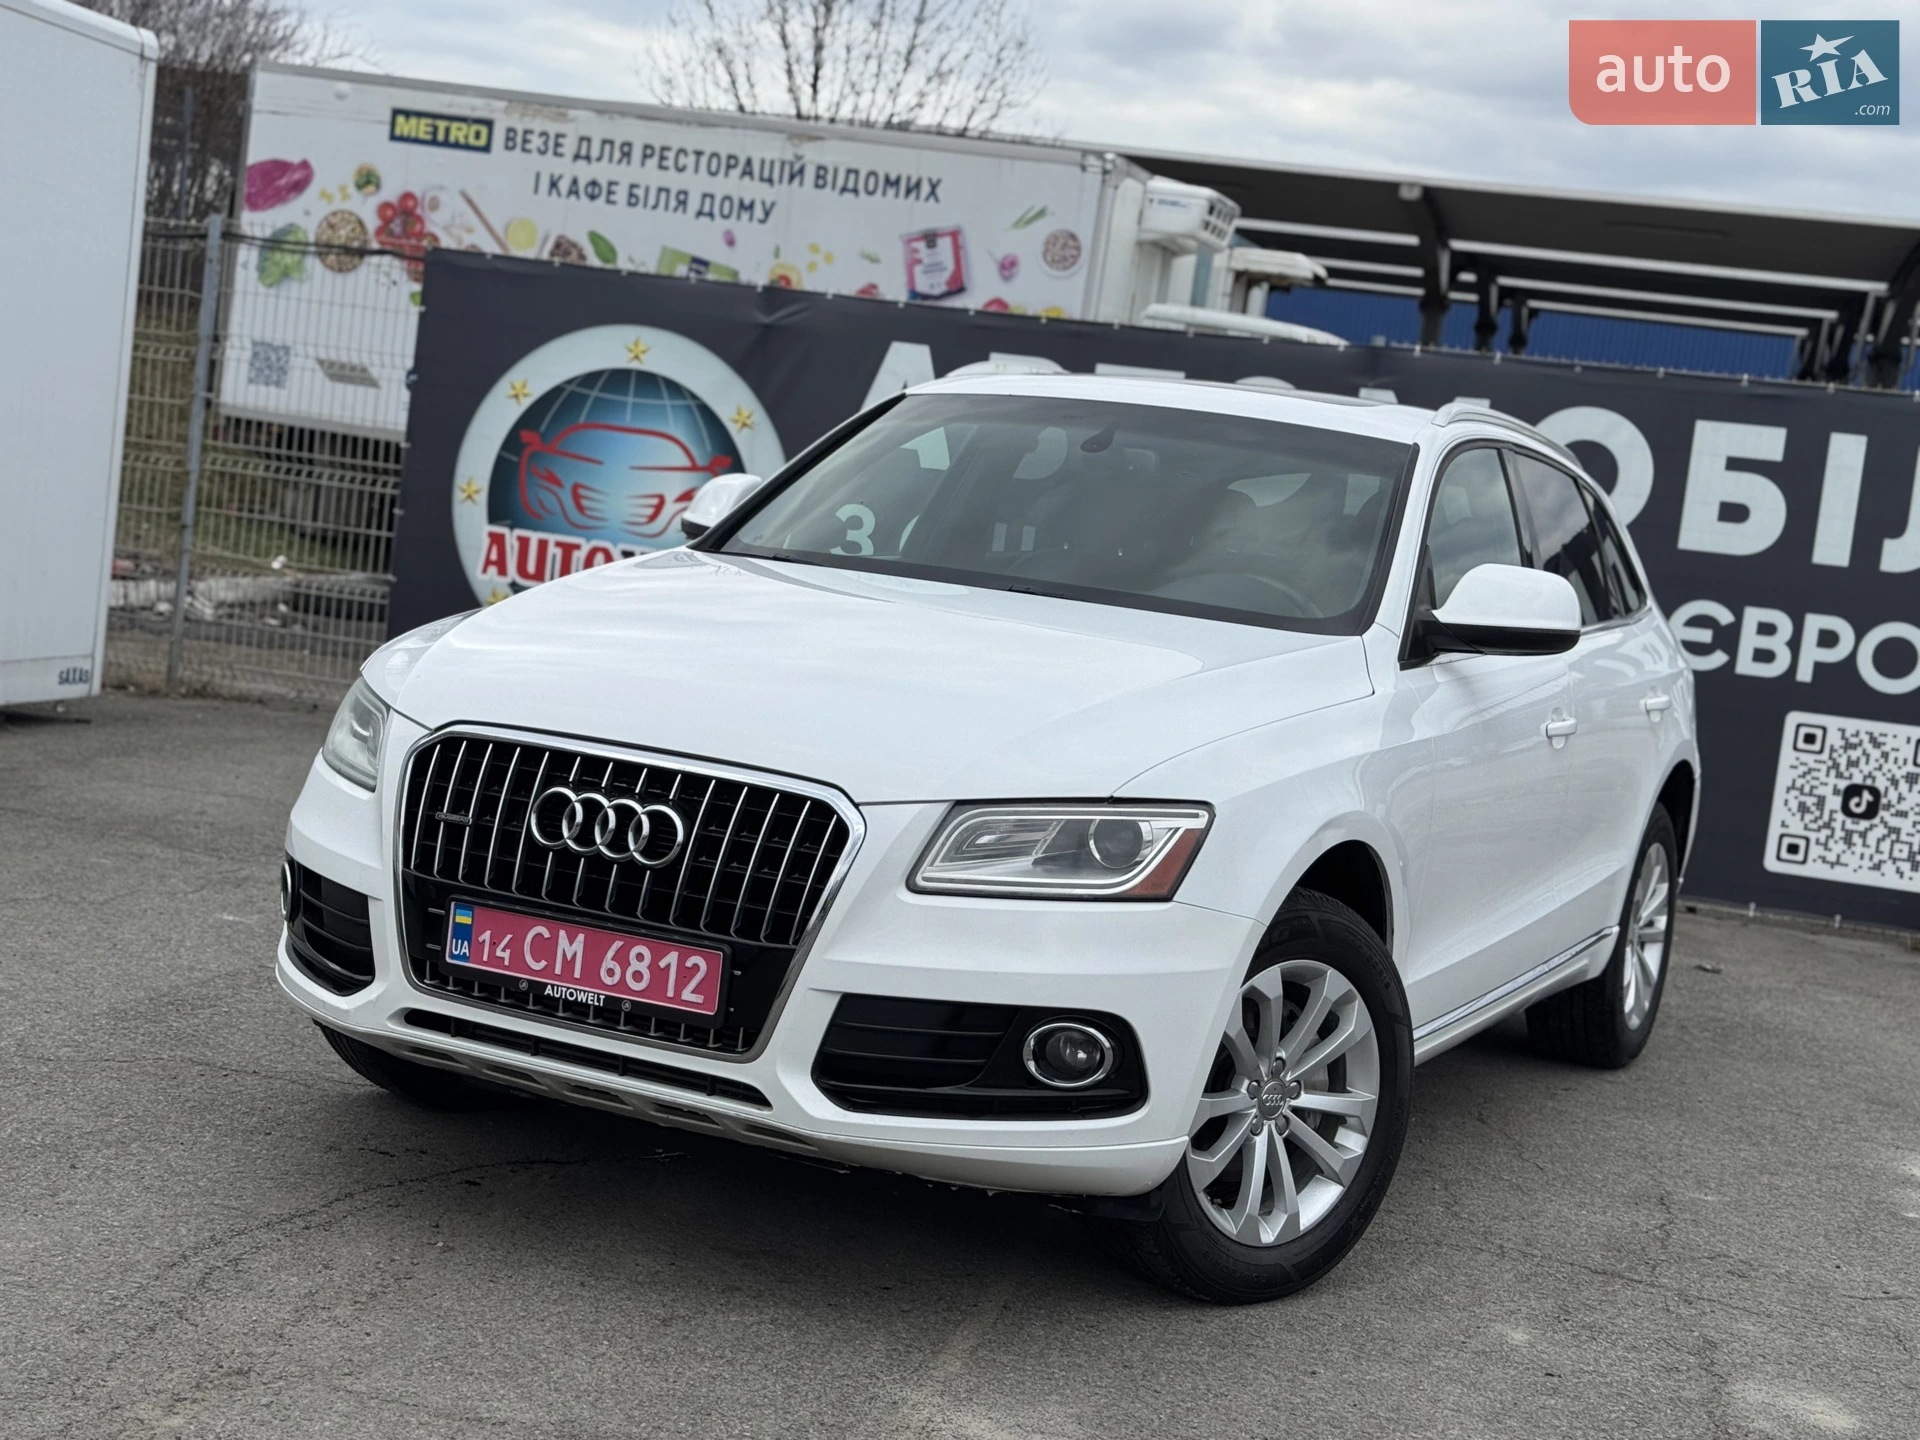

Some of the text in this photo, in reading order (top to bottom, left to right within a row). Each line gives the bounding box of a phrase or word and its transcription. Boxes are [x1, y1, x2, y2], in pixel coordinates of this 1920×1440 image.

[394, 114, 490, 148] METRO
[504, 127, 942, 203] ВЕЗЕ ДЛЯ РЕСТОРАЦІЙ ВІДОМИХ
[548, 173, 619, 206] КАФЕ
[626, 183, 689, 214] БІЛЯ
[696, 192, 776, 225] ДОМУ
[452, 938, 470, 957] UA
[477, 926, 708, 1004] 14 CM 6812
[544, 984, 606, 1006] AUTOWELT
